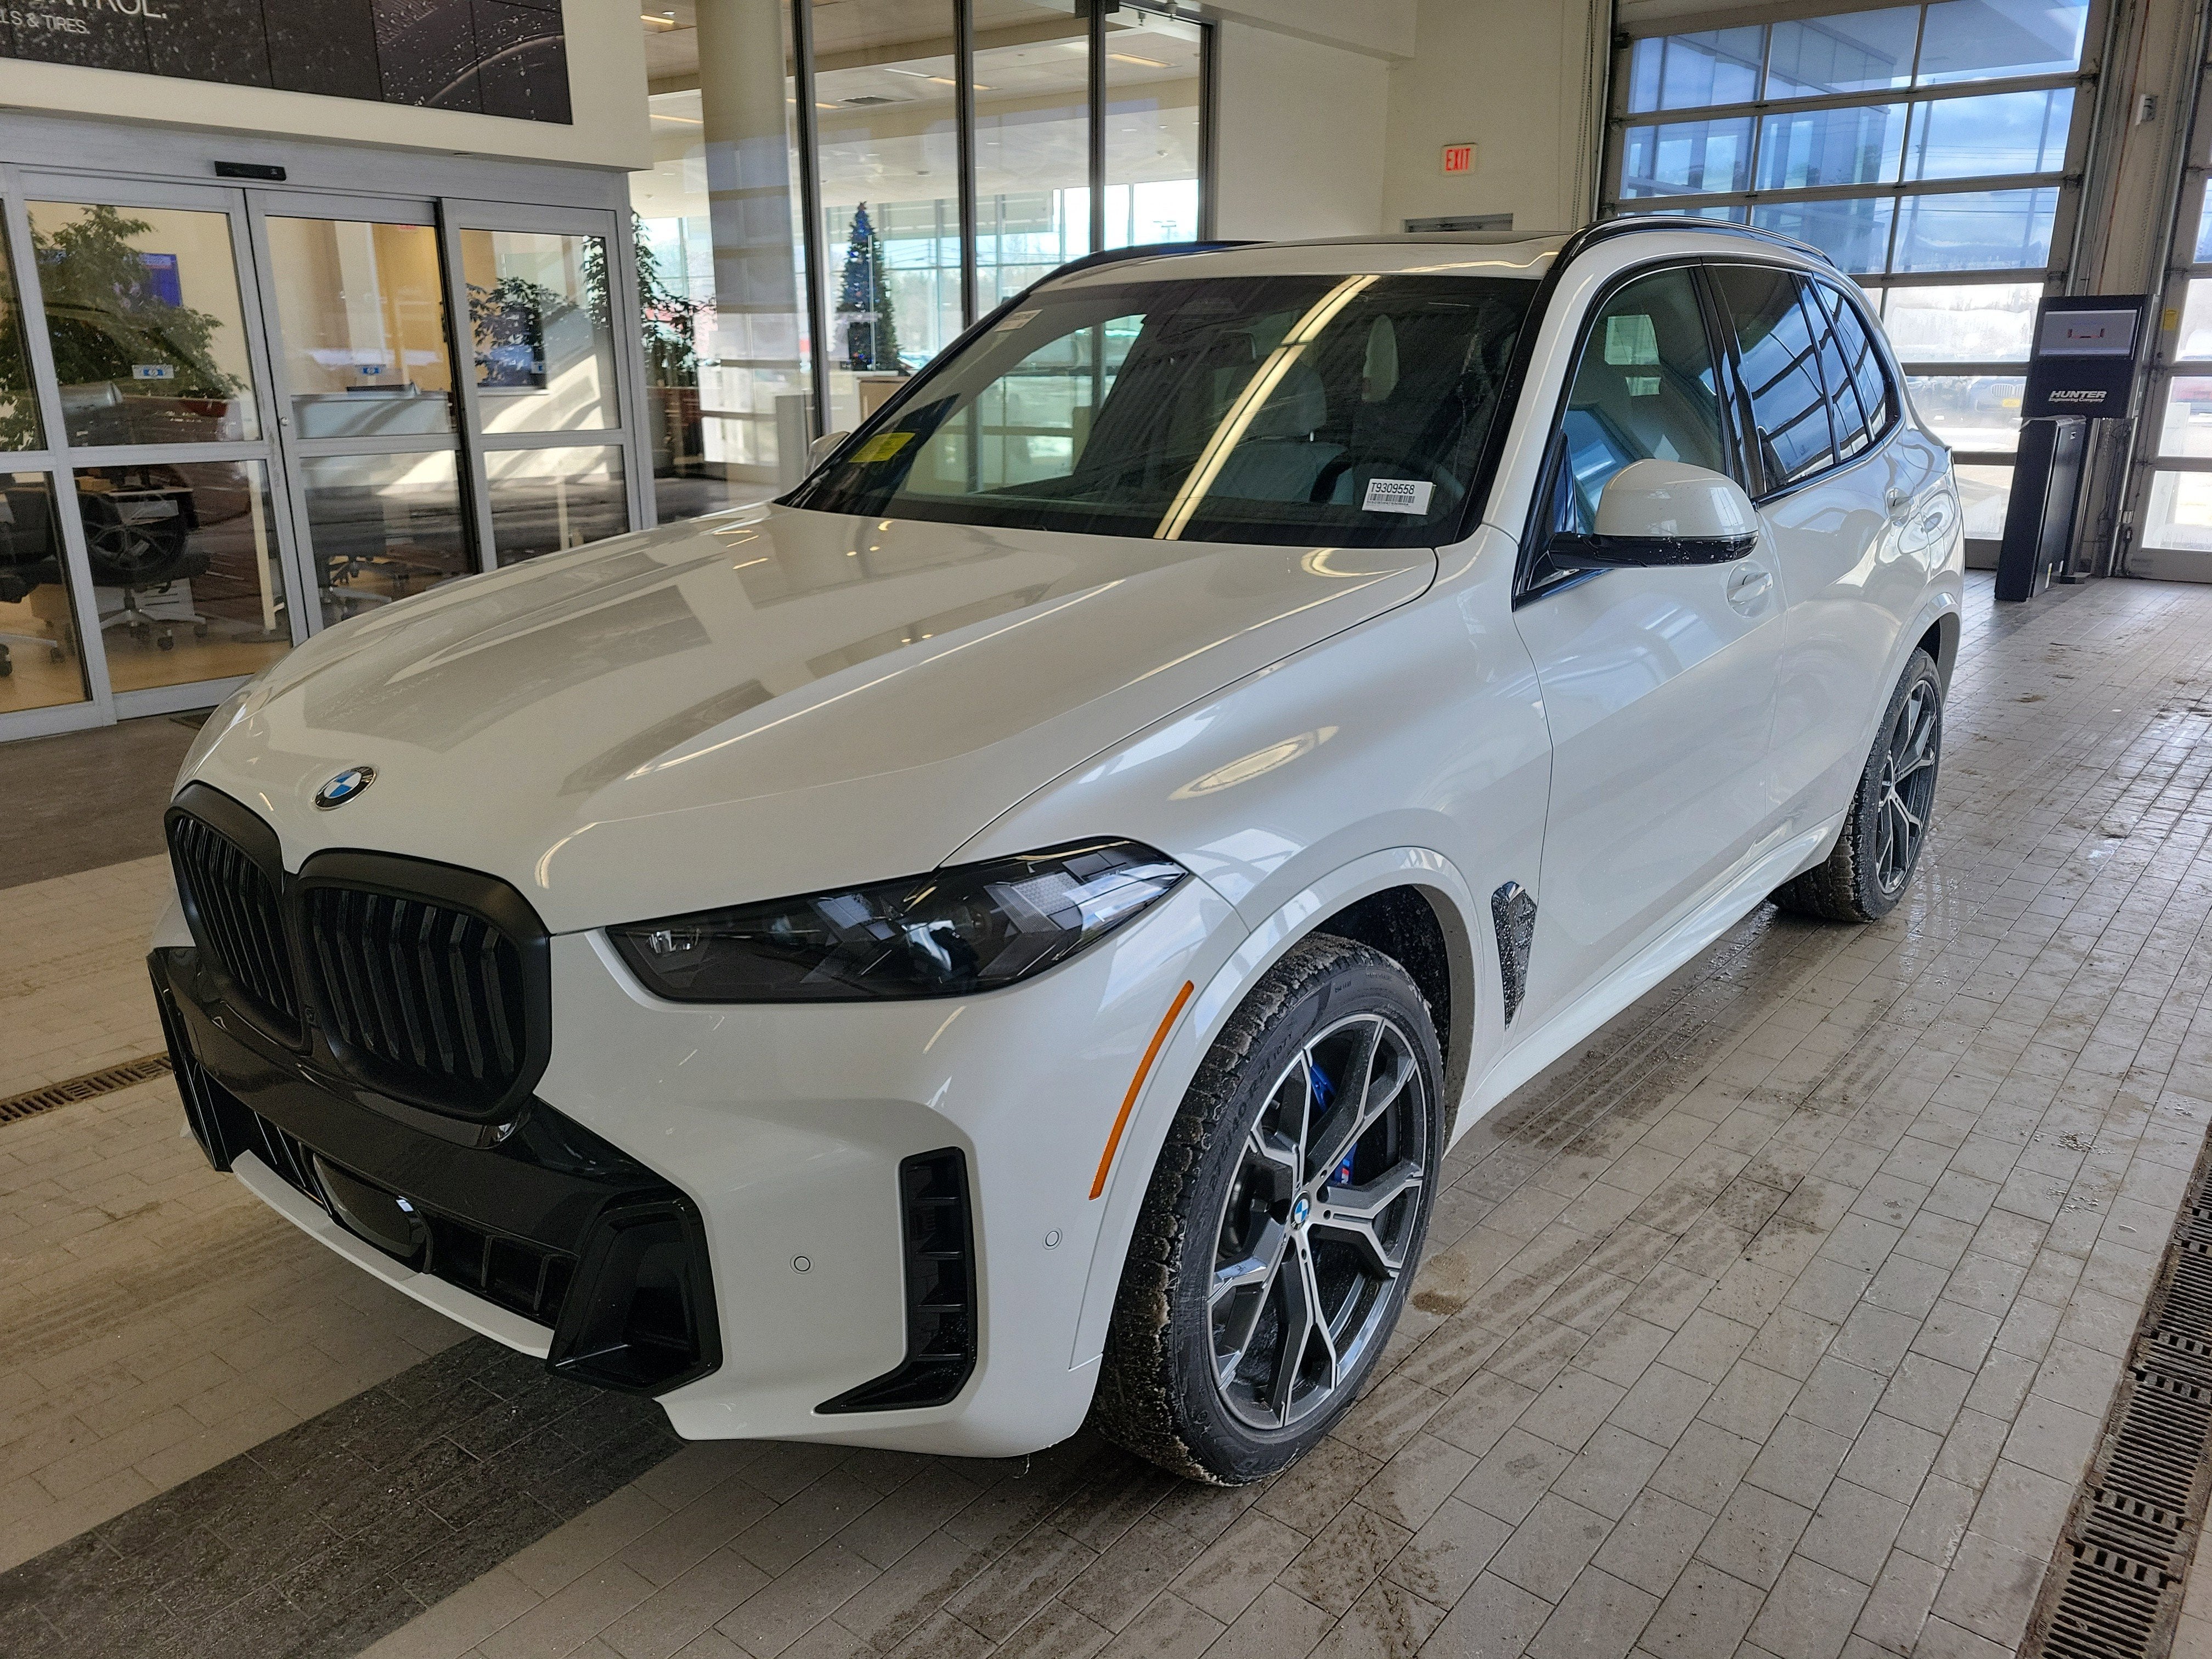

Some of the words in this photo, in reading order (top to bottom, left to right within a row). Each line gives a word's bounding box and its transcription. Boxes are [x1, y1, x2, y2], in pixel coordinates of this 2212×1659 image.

[25, 13, 39, 27] &
[41, 14, 91, 34] TIRES.
[1445, 148, 1471, 171] EXIT
[1372, 482, 1415, 494] T9309558
